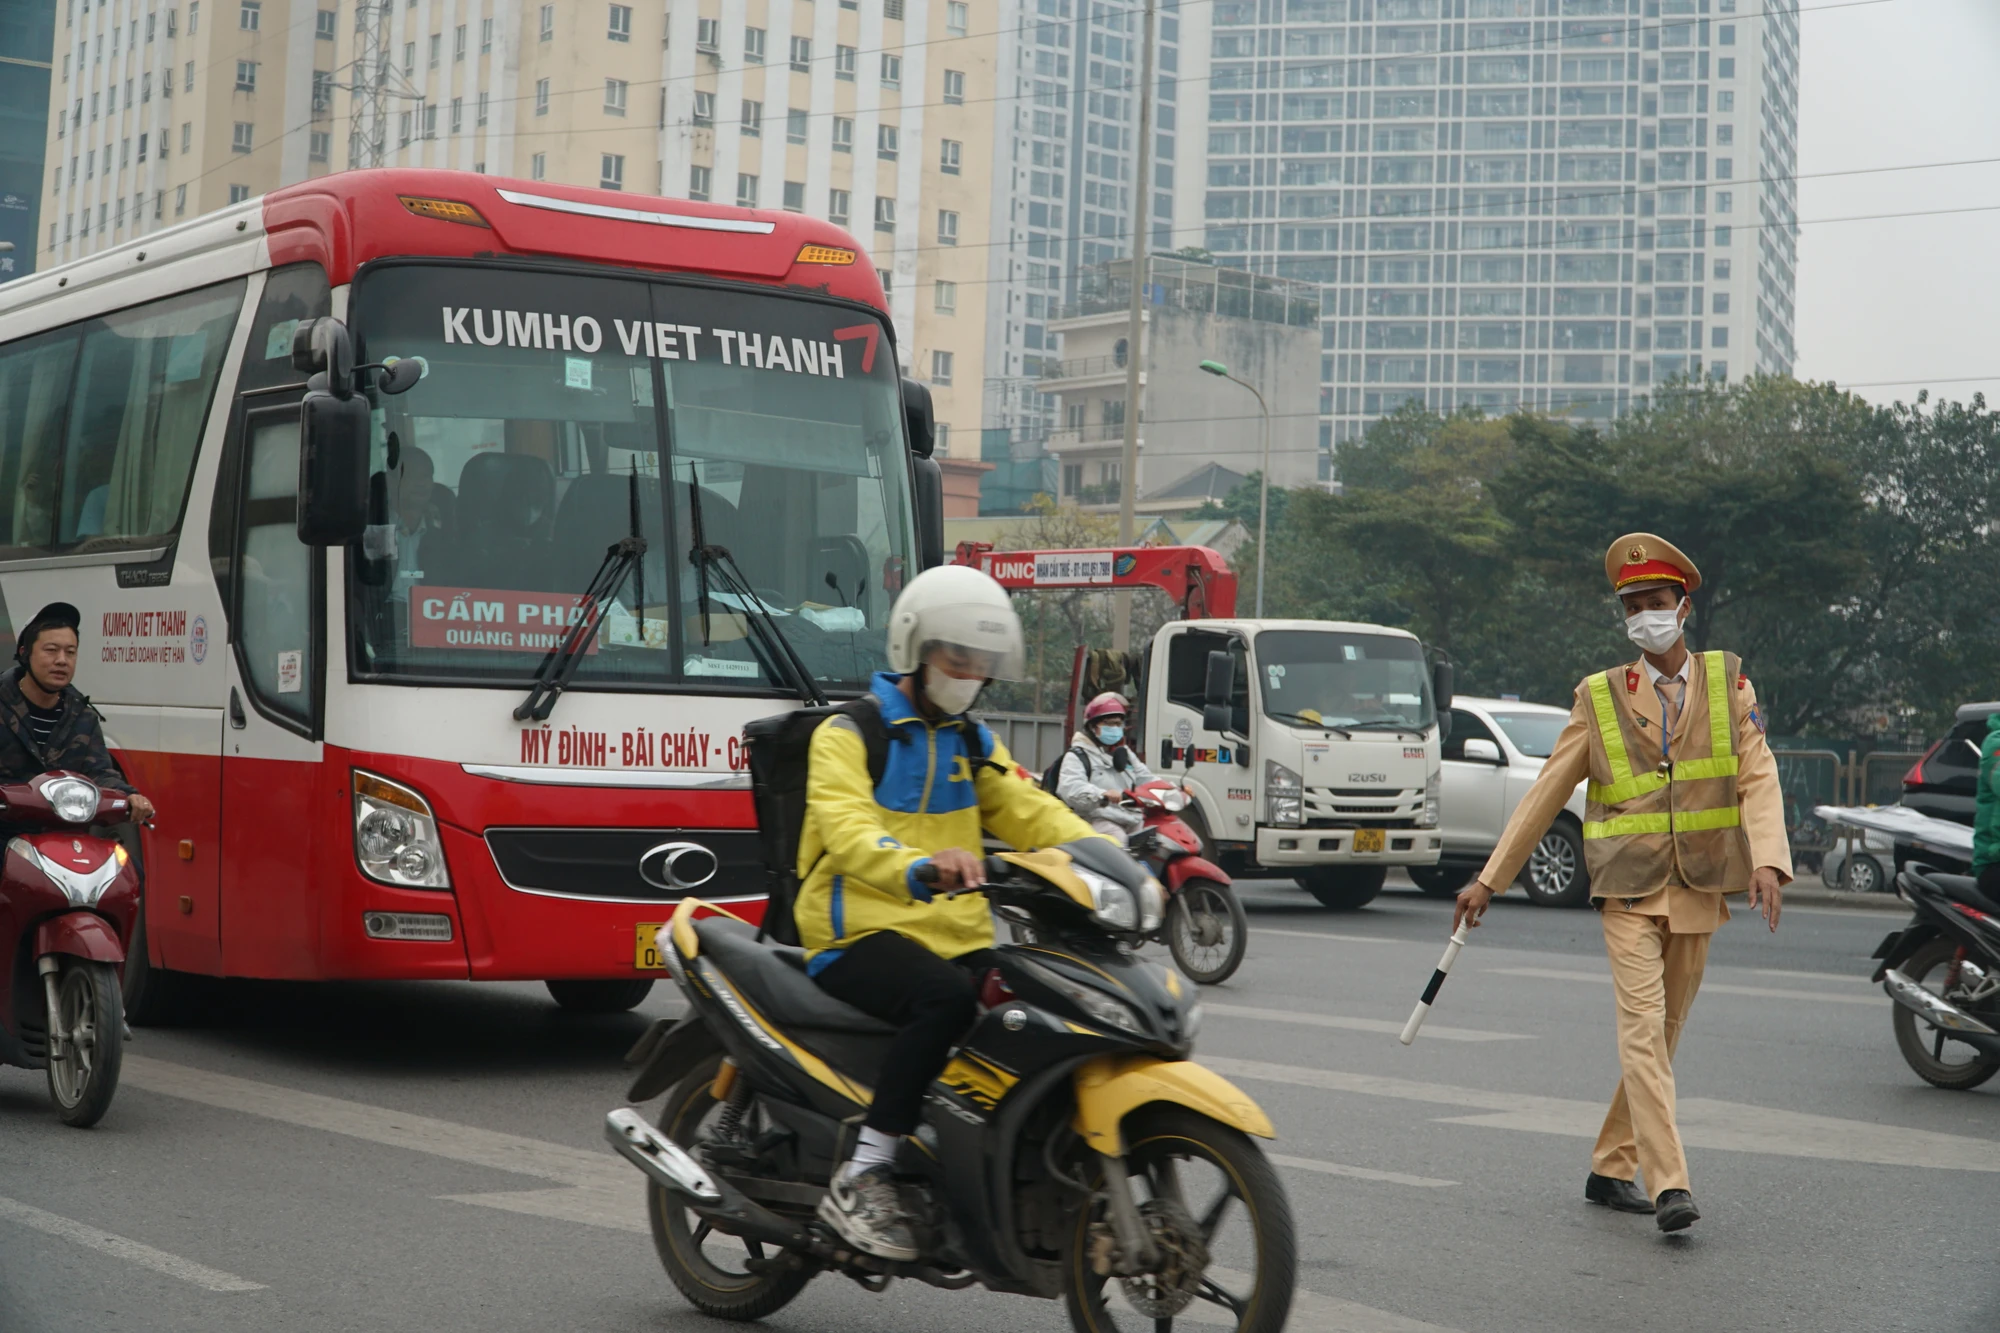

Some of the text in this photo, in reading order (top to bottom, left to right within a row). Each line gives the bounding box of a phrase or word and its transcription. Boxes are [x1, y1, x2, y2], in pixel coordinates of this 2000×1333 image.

[442, 306, 845, 379] KUMHO VIET THANH
[121, 570, 148, 582] THACO
[995, 562, 1034, 579] UNIC
[422, 592, 589, 627] CẨM PHẢ
[102, 610, 186, 637] KUMHO VIET THANH
[446, 624, 513, 647] QUẢNG
[118, 646, 125, 663] TY
[138, 646, 158, 663] DOANH
[521, 724, 552, 764] MỸ
[558, 725, 606, 766] ĐÌNH
[622, 727, 653, 767] BÃI
[661, 727, 710, 767] CHÁY
[1176, 747, 1230, 763] IUZU
